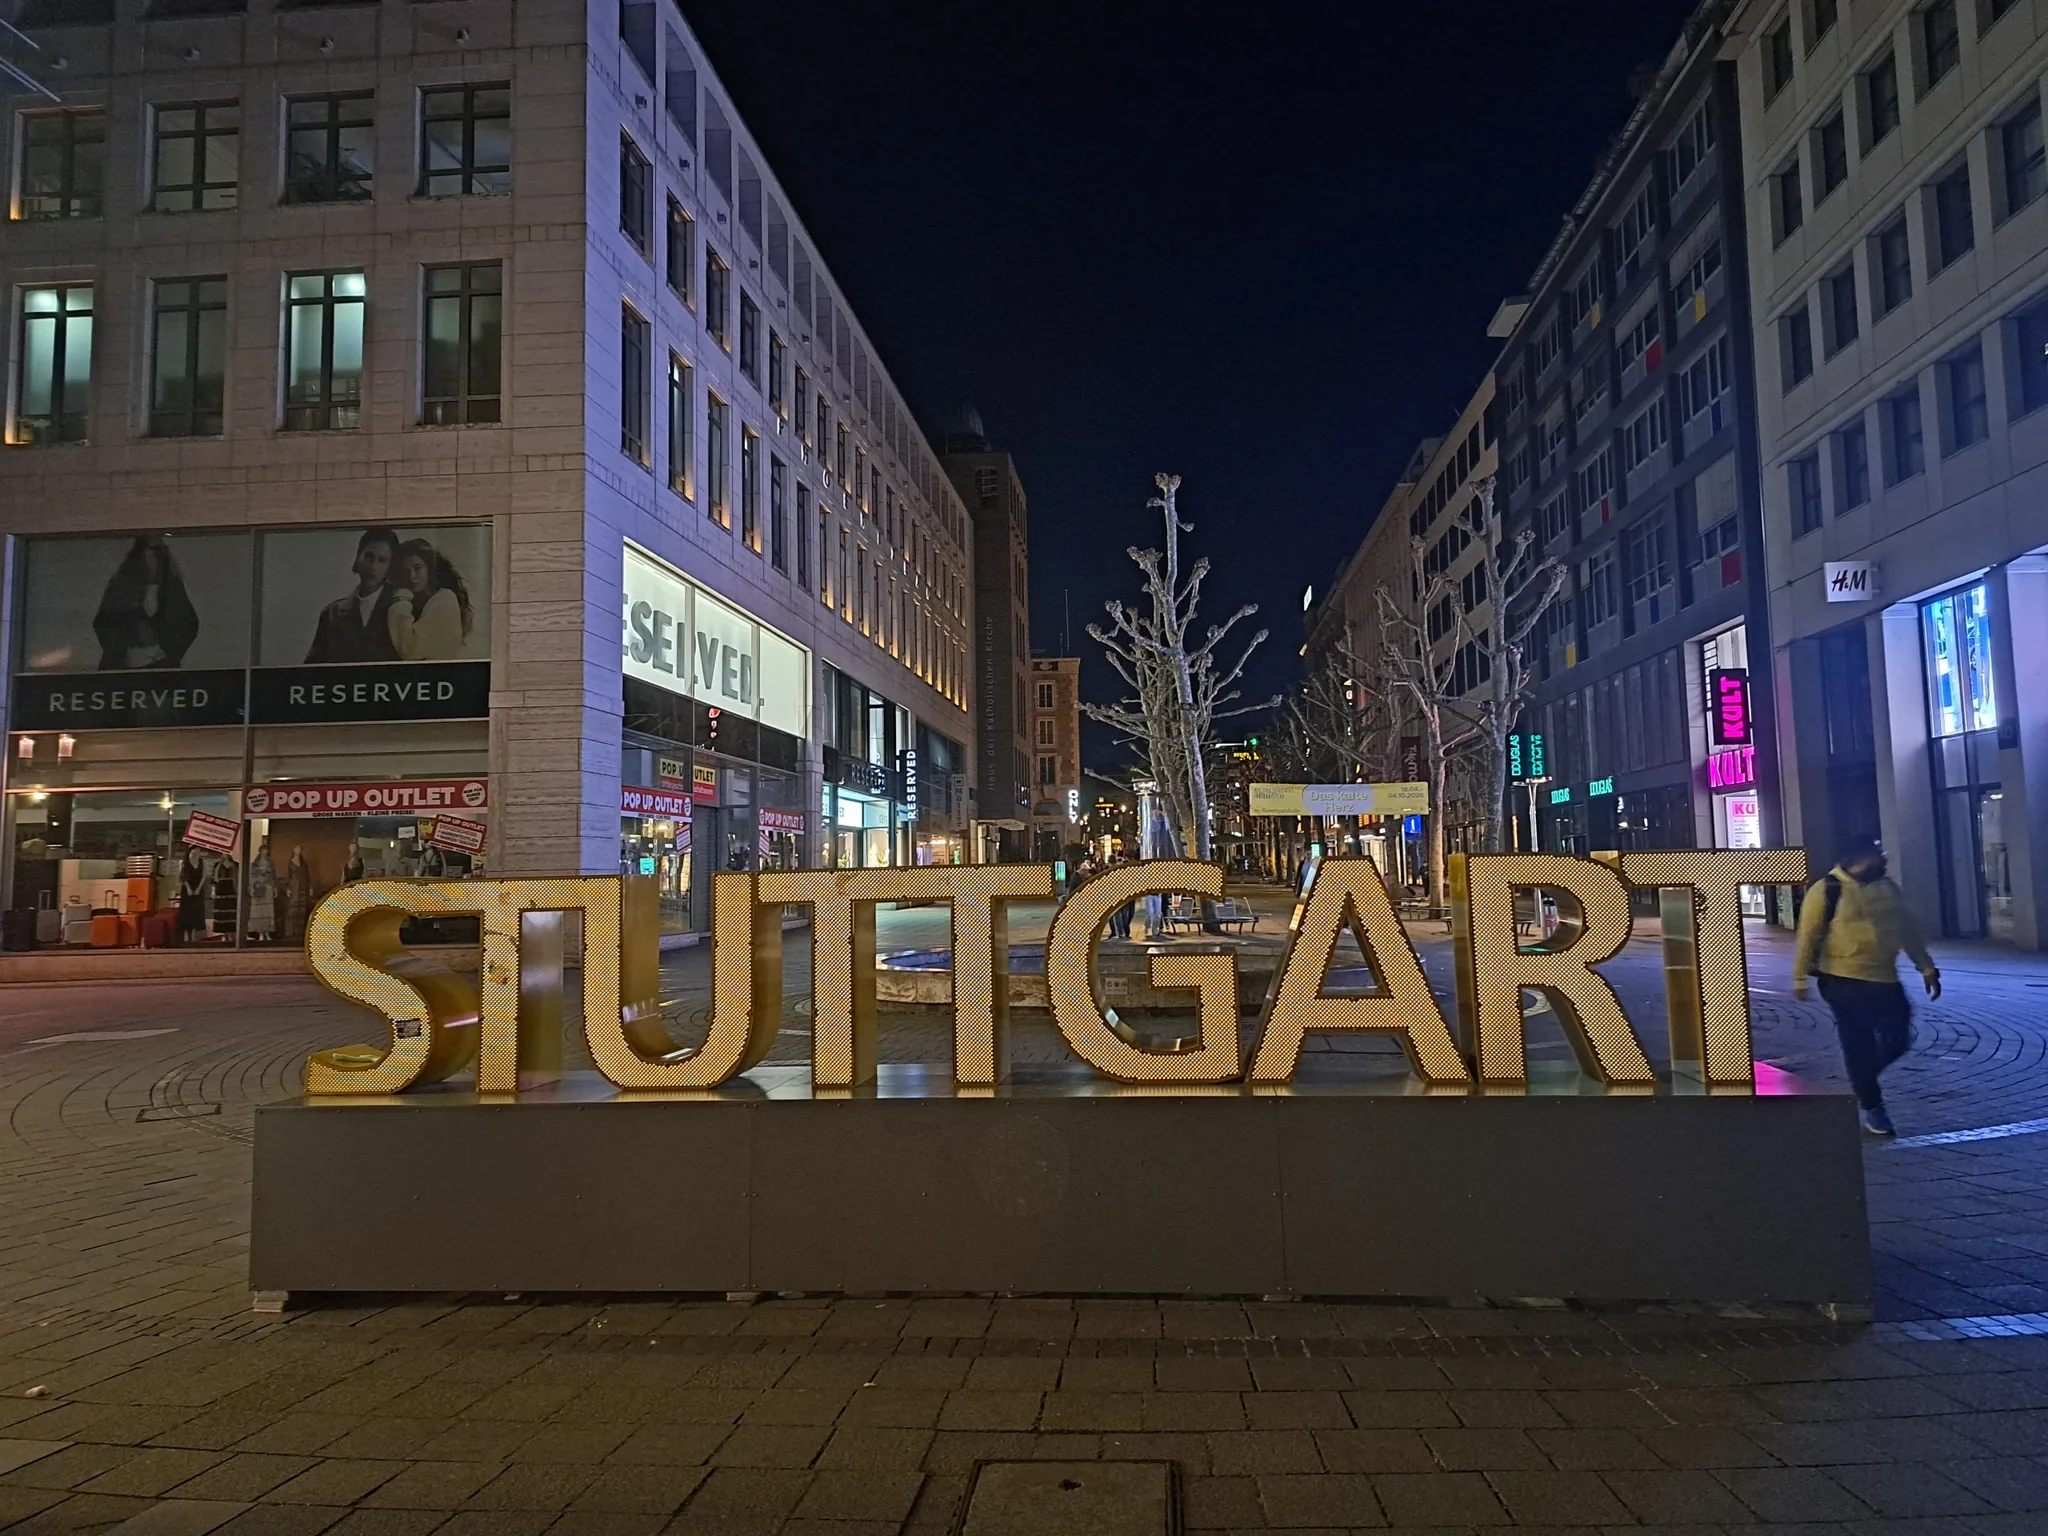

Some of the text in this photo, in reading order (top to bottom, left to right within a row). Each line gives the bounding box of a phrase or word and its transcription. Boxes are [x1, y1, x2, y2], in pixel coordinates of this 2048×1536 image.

[1831, 569, 1867, 592] H&M
[49, 688, 209, 713] RESERVED
[290, 681, 455, 705] RESERVED
[985, 616, 995, 790] Haus der Katholischen Kirche
[1720, 676, 1744, 738] KULT
[1509, 734, 1522, 776] DOUGLAS
[661, 761, 677, 776] POP
[694, 768, 714, 783] UTLET
[1708, 746, 1755, 788] KULT
[906, 750, 917, 819] RESERVED
[1310, 790, 1336, 801] Das
[273, 787, 456, 810] POP UP OUTLET
[623, 791, 641, 809] POP
[642, 794, 654, 811] UP
[654, 796, 683, 814] OUTLET
[1068, 789, 1080, 824] ONLY
[1325, 802, 1354, 813] Herz
[461, 820, 486, 831] OUTLET
[764, 811, 799, 829] POP UP OUTLET
[304, 848, 1808, 1098] STUTTGART
